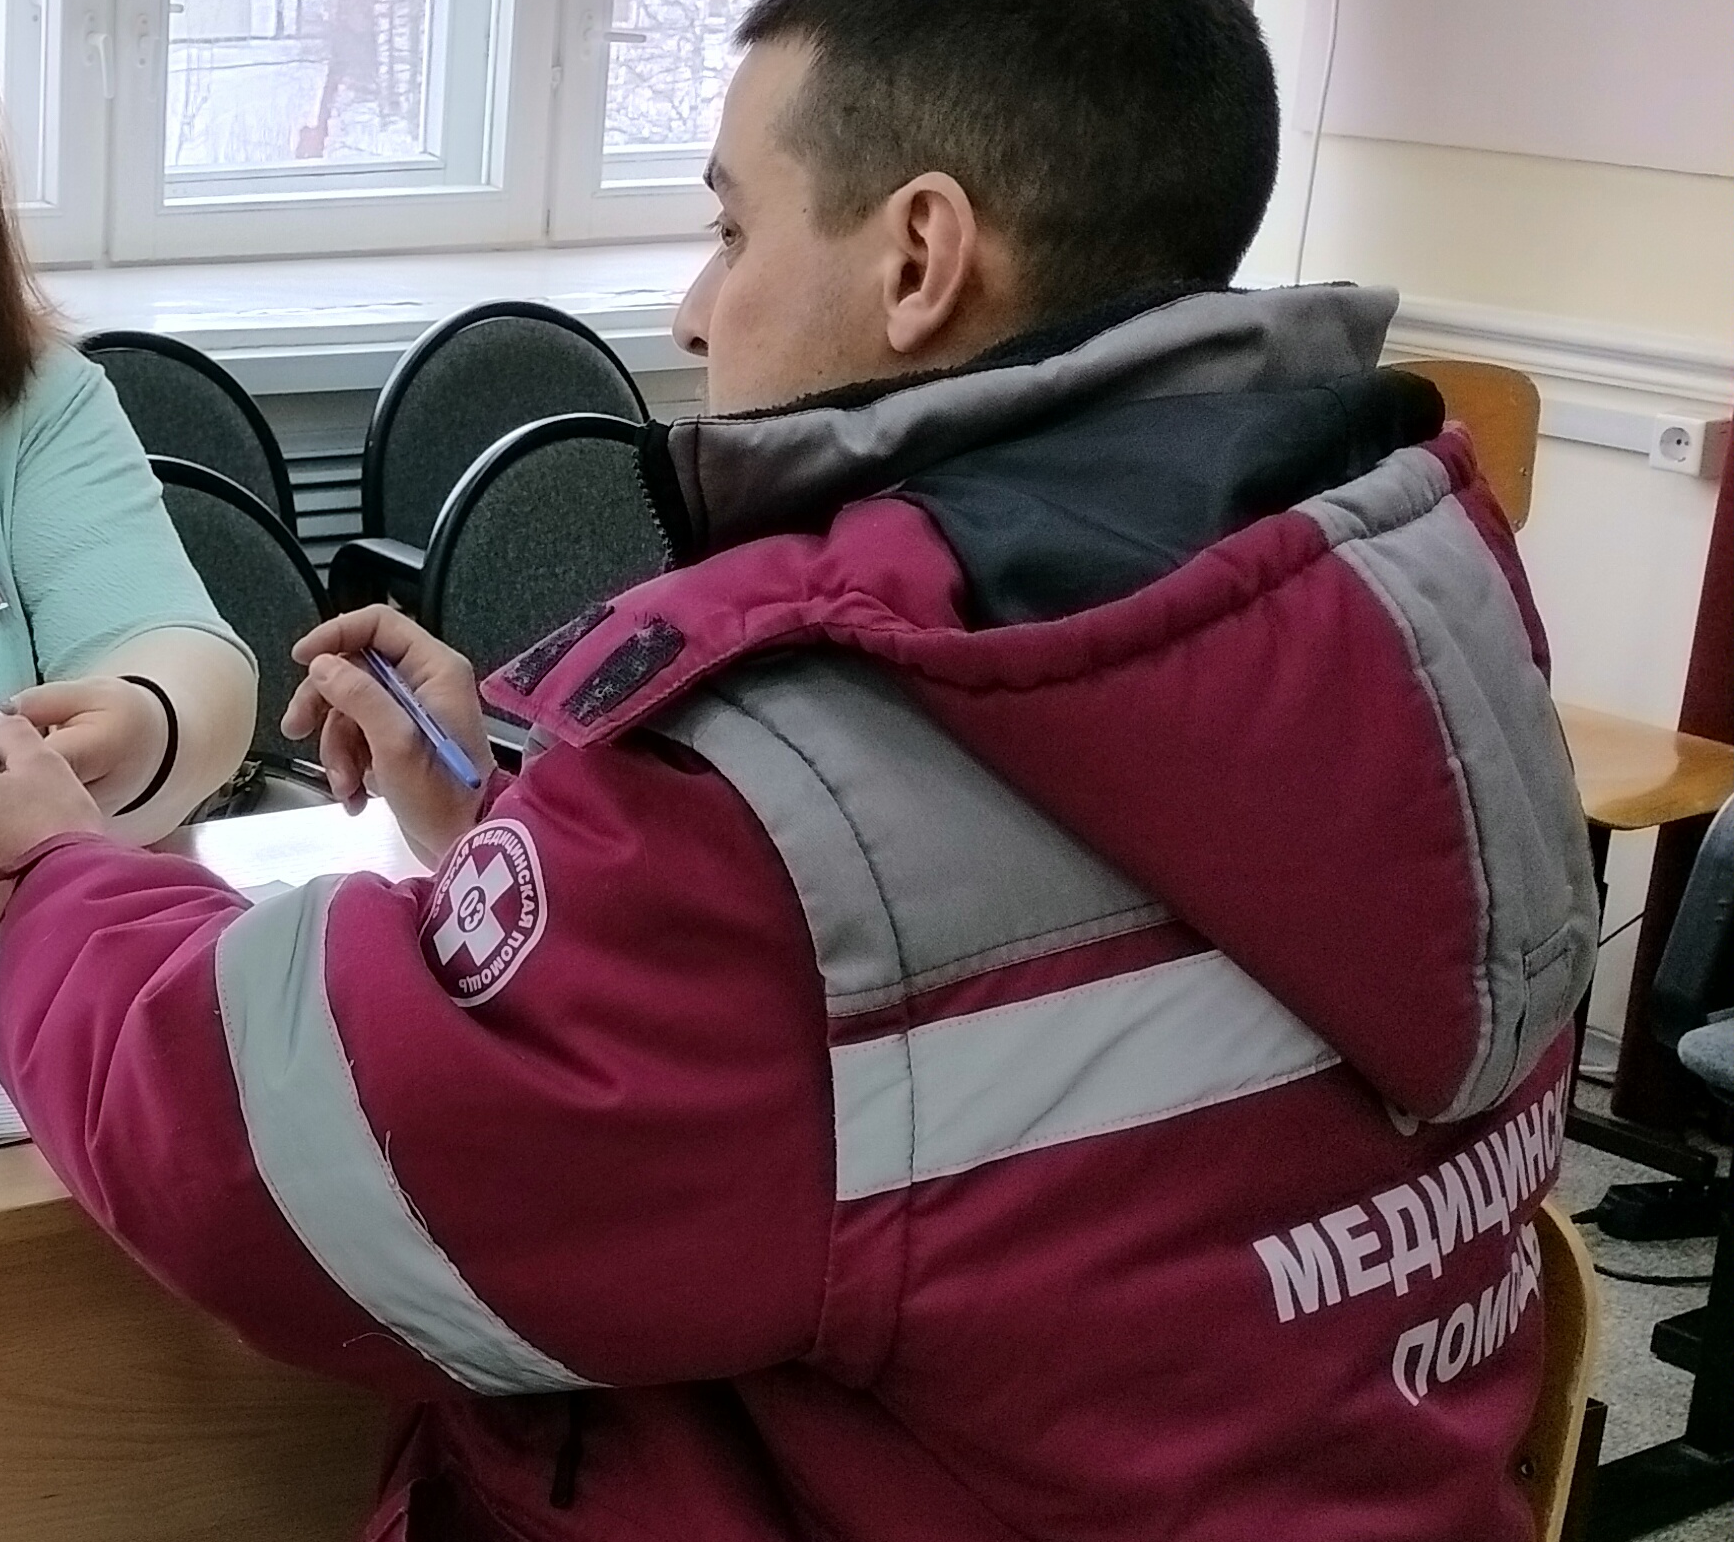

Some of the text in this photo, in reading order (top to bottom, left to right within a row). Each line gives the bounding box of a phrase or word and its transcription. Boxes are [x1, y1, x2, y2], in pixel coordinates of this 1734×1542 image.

[459, 889, 485, 932] 03
[472, 829, 536, 929] МЕДИЦИНСКАЯ
[458, 930, 526, 993] ПОМОЩЬ
[1252, 1069, 1569, 1323] МЕДИЦИНСК
